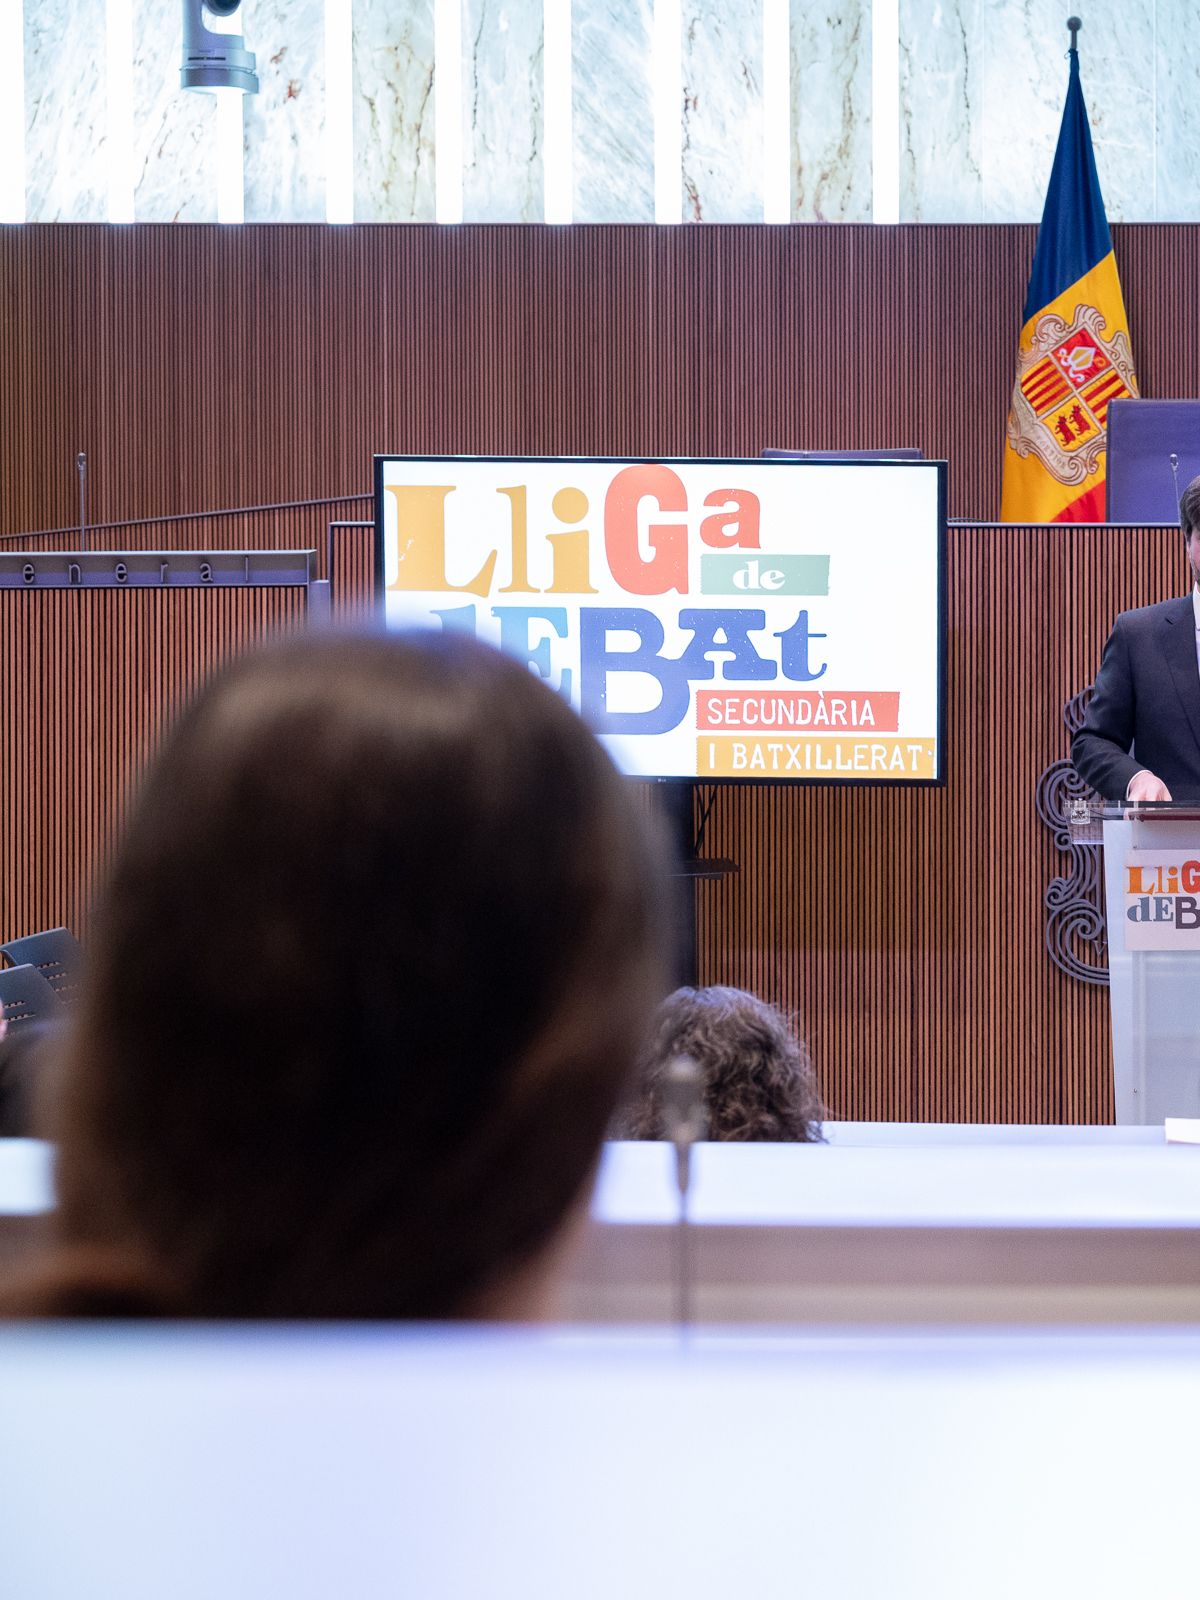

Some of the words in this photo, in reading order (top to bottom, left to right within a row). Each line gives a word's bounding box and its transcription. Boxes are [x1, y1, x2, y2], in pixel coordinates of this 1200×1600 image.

[384, 463, 762, 598] LliGa
[732, 560, 786, 591] de
[430, 603, 828, 736] EBAt
[707, 690, 875, 726] SECUNDÀRIA
[708, 743, 716, 769] I
[732, 742, 923, 771] BATXILLERAT
